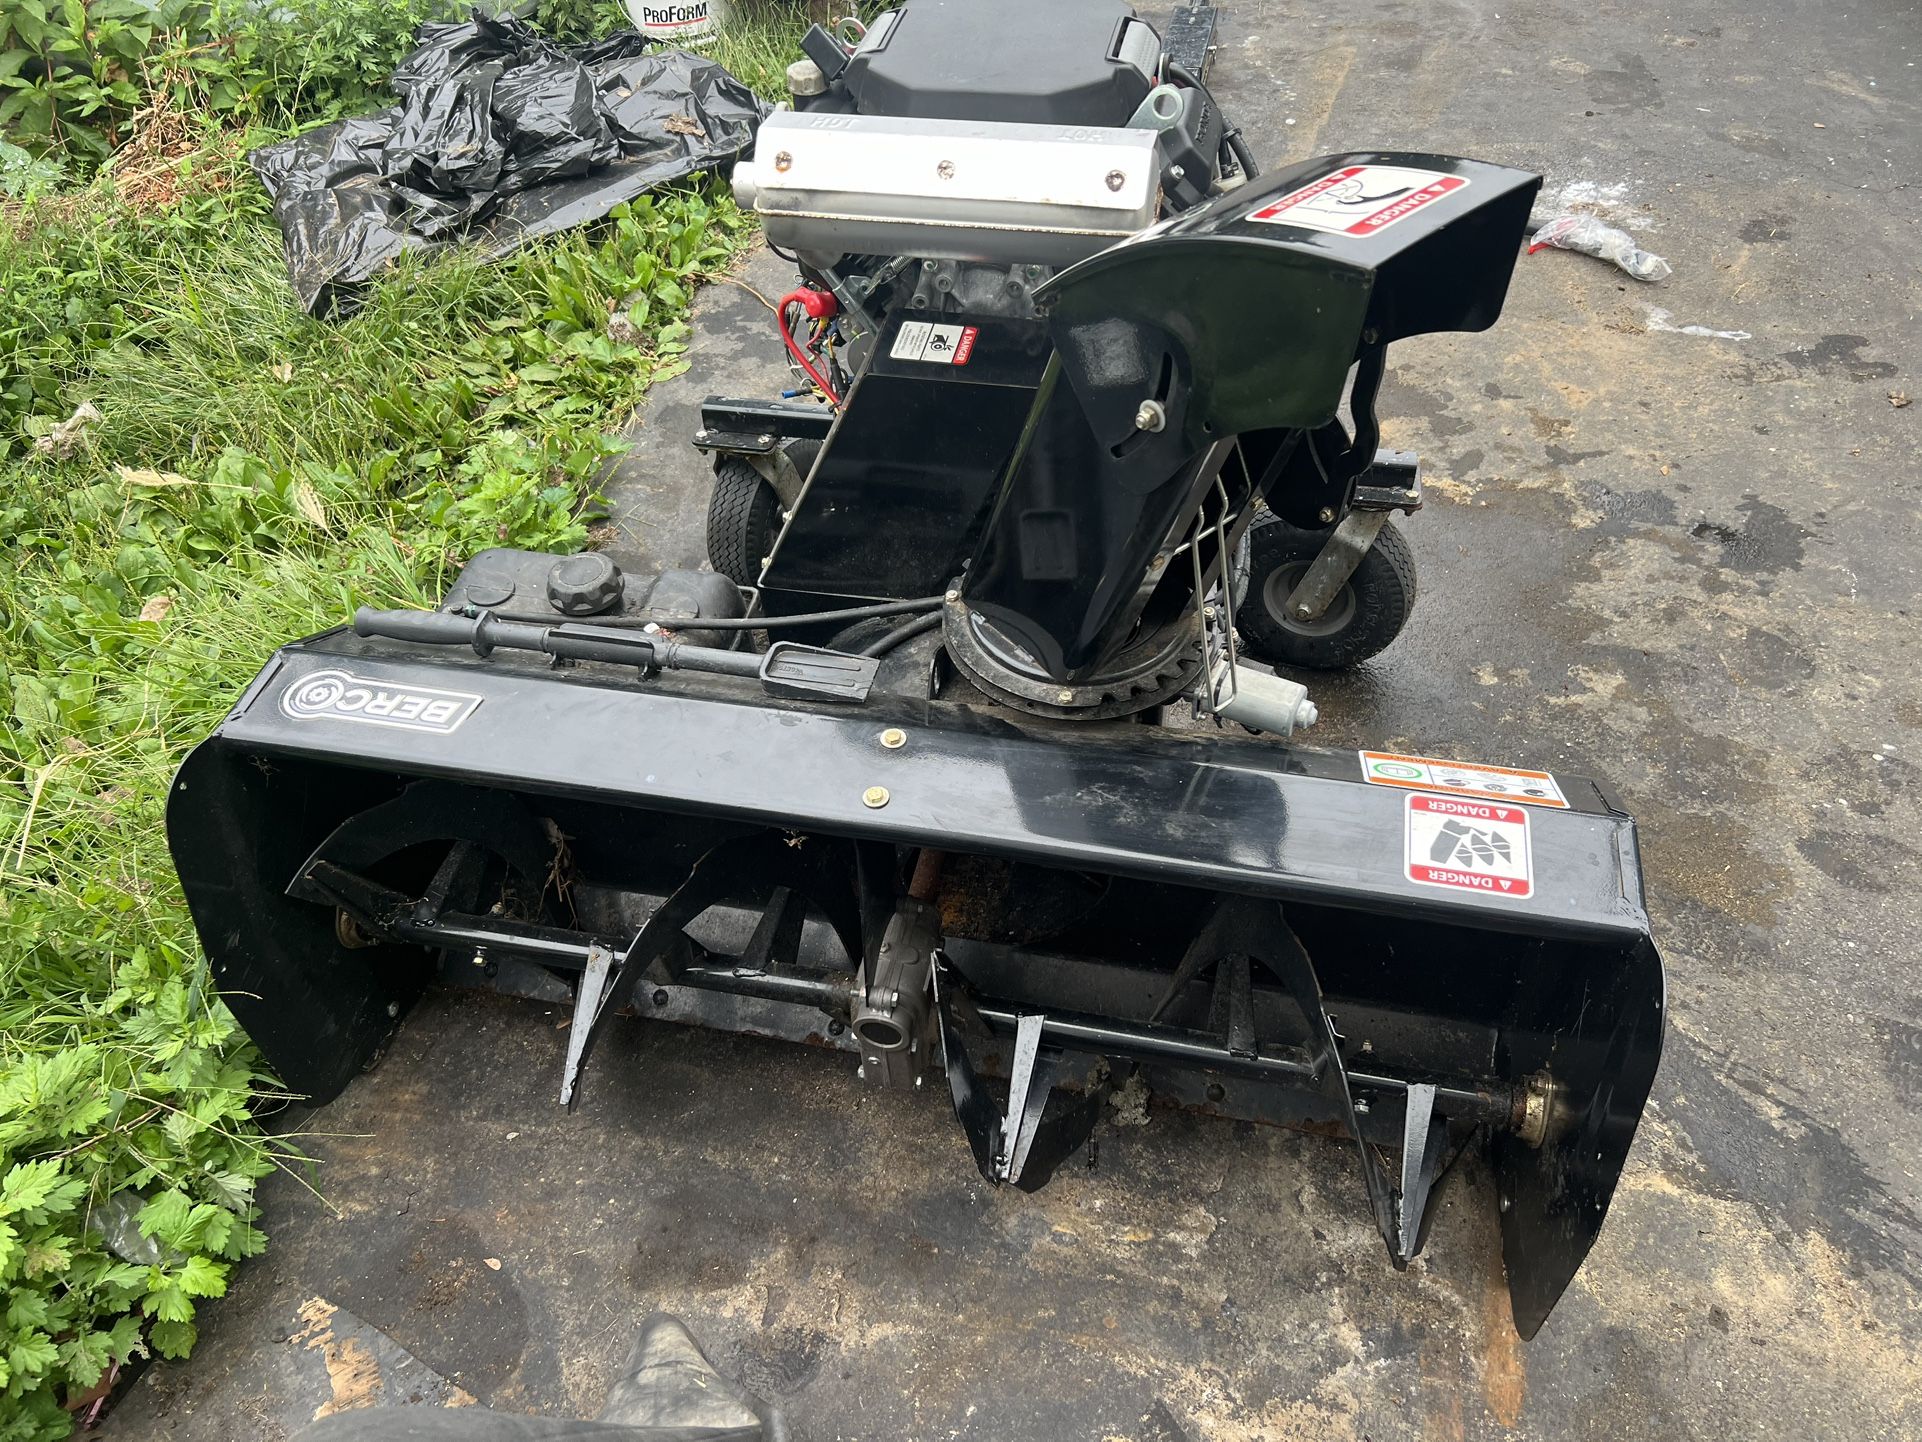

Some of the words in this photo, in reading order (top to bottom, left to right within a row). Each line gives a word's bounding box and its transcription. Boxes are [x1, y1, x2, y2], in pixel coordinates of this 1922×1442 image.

[810, 116, 860, 129] HOT
[1271, 176, 1335, 211] DANGER
[1364, 194, 1432, 226] DANGER
[956, 336, 973, 361] DANGER
[1427, 800, 1491, 818] DANGER
[1428, 869, 1493, 888] DANGER
